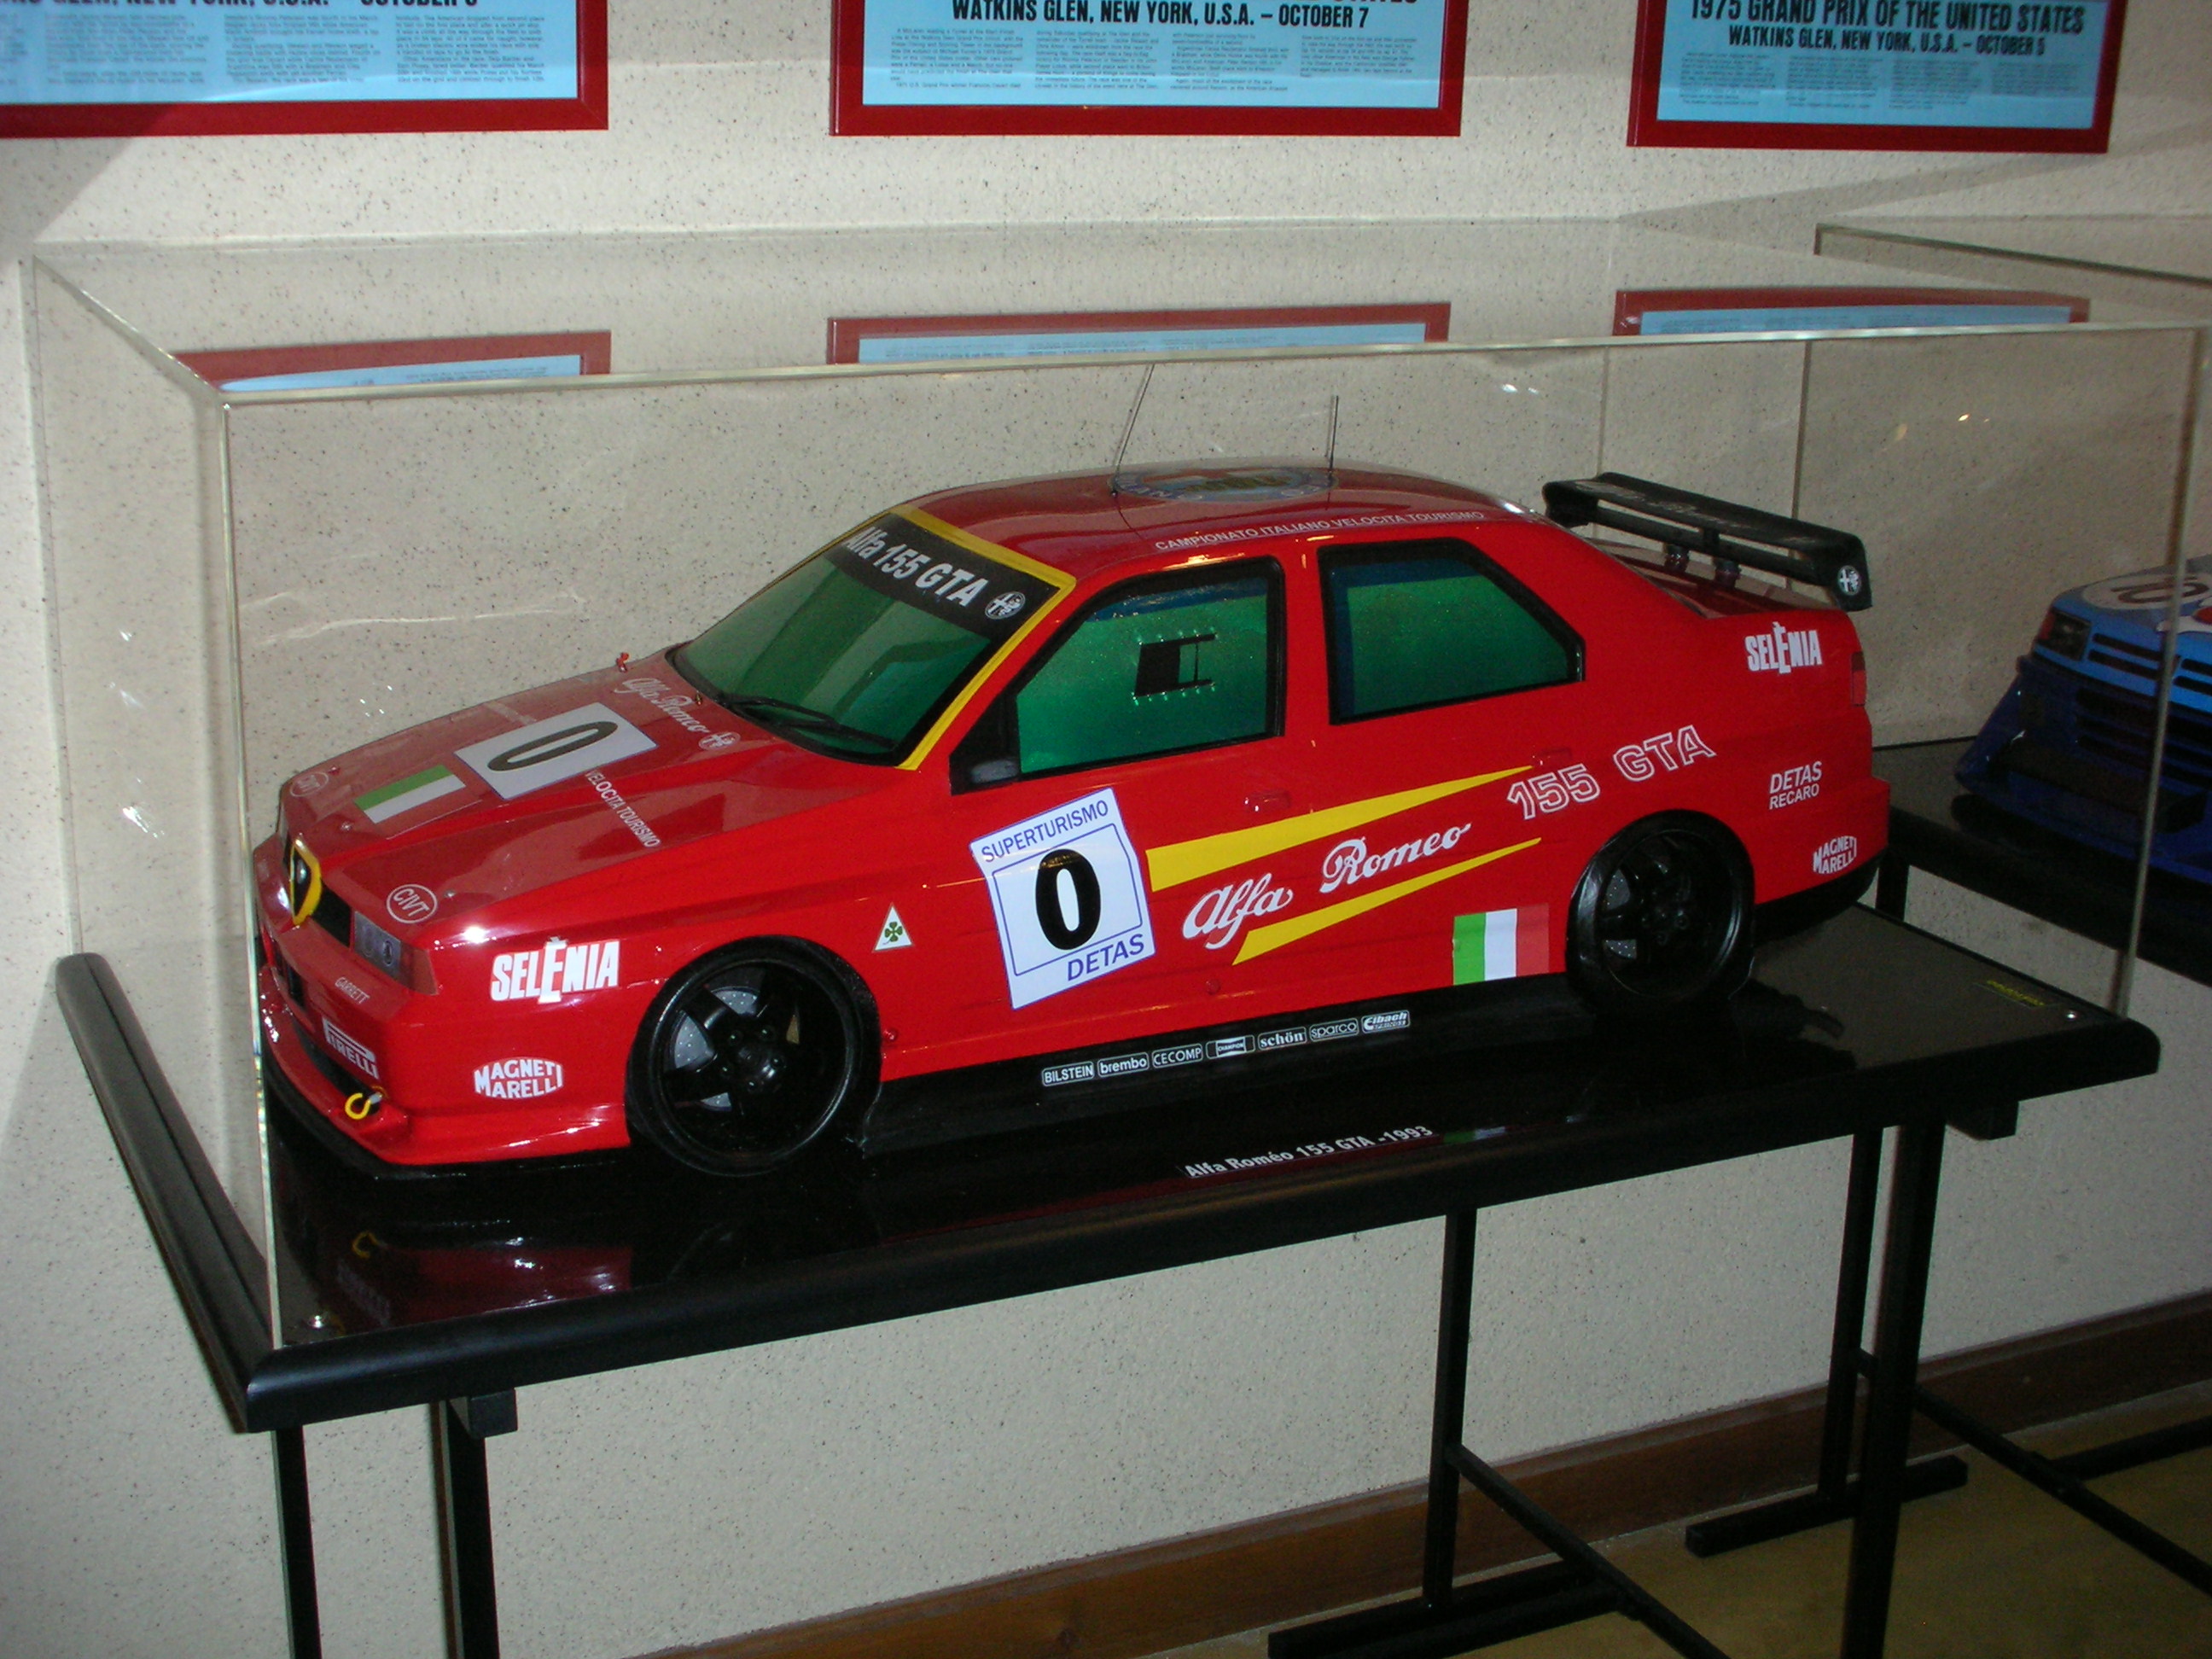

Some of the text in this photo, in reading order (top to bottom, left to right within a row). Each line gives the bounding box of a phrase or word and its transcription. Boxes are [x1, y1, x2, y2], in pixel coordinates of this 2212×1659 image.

[952, 0, 1037, 21] WATKINS
[1044, 0, 1094, 24] GLEN,
[1100, 1, 1141, 23] NEW
[1146, 1, 1199, 26] YORK,
[1204, 3, 1254, 26] U.S.A.
[1278, 4, 1353, 27] OCTOBER
[1359, 7, 1369, 28] 7
[1748, 0, 1816, 24] GRAND
[1823, 0, 1869, 26] PRIX
[1876, 0, 1900, 27] OF
[1906, 1, 1941, 29] THE
[1946, 2, 2012, 32] UNITED
[2017, 4, 2086, 35] STATES
[1729, 25, 1794, 48] WATKINS
[1841, 29, 1871, 50] NEW
[1876, 31, 1915, 53] YORK,
[1920, 32, 1958, 53] U.S.A.
[1976, 34, 2034, 55] OCTOBER
[1155, 510, 1486, 551] CAMPIONATO ITALIANO VELOCITA TOURISMO
[873, 544, 932, 579] 155
[915, 562, 989, 608] GTA
[650, 695, 711, 734] Romeo
[487, 721, 619, 772] 0
[1506, 724, 1716, 820] 155 GTA
[1769, 760, 1823, 795] DETAS
[1768, 783, 1820, 811] RECARO
[616, 805, 661, 847] TOURISMO
[981, 799, 1109, 863] SUPERTURISMO
[393, 888, 430, 918] CIVT
[1035, 848, 1102, 952] 0
[1182, 823, 1471, 950] Alfa Romeo
[1067, 934, 1145, 981] DETAS
[322, 1015, 381, 1080] PIRELLI
[1044, 1064, 1094, 1084] BILSTEIN
[1100, 1057, 1147, 1074] brembo
[1153, 1047, 1202, 1065] CECOMP
[1218, 1042, 1244, 1052] CHAMPION
[1260, 1031, 1304, 1048] schön
[1311, 1022, 1357, 1039] sparco
[474, 1057, 563, 1084] MAGNETI
[474, 1068, 563, 1099] MARELLI
[1185, 1161, 1226, 1179] Alfa
[1225, 1150, 1295, 1171] Roméo
[1295, 1142, 1336, 1157] 155
[1335, 1135, 1376, 1150] GTA
